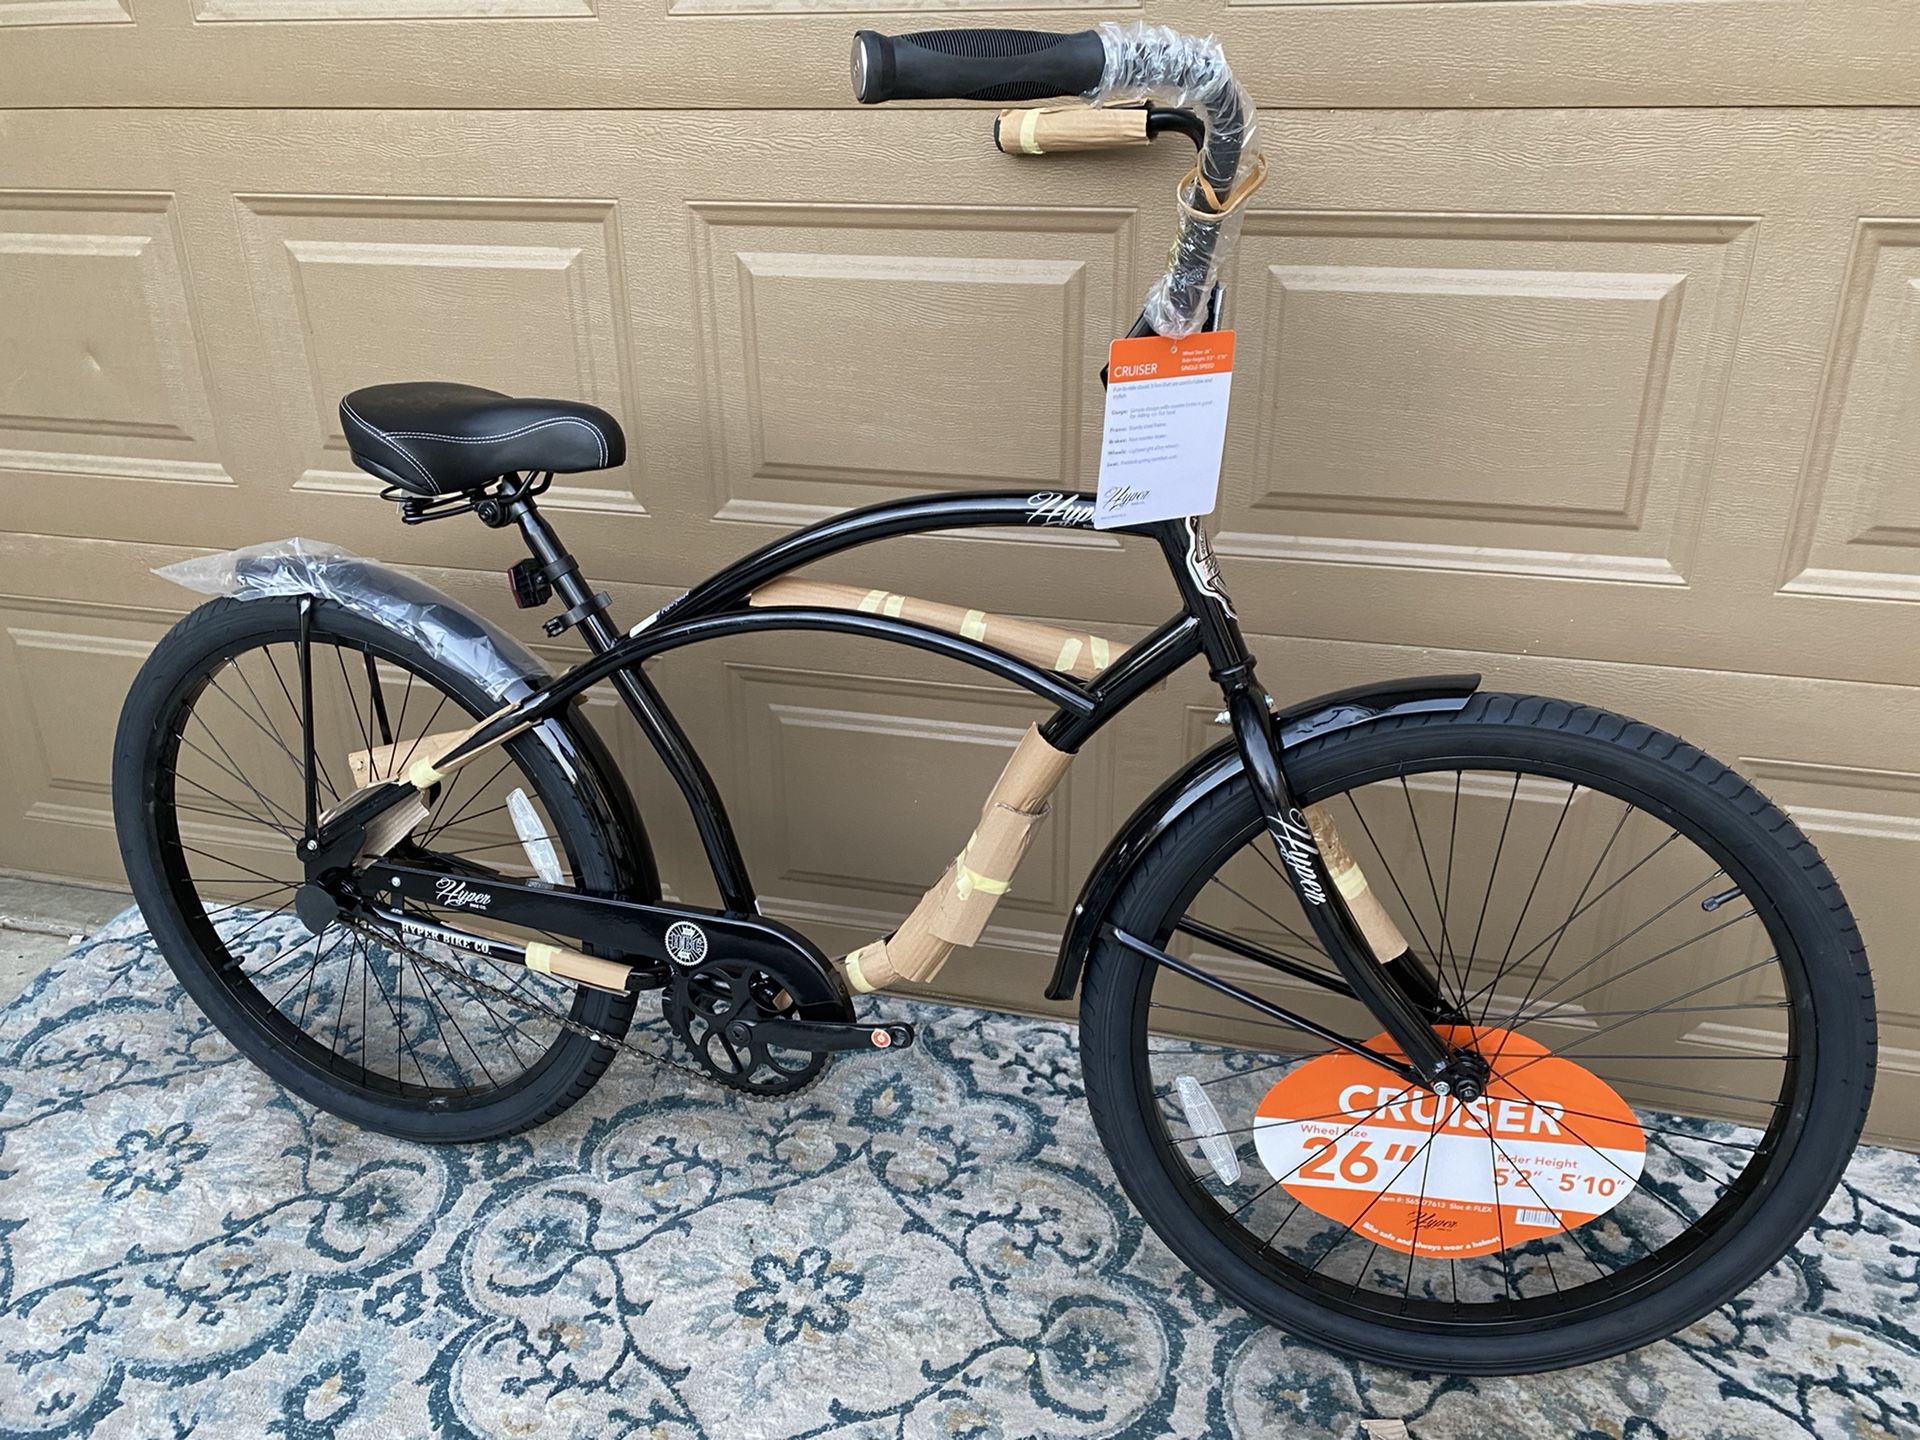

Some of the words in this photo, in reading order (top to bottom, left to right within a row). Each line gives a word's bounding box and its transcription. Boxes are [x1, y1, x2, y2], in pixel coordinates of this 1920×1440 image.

[1113, 363, 1158, 378] CRUISER
[1025, 491, 1096, 526] Hyp
[1267, 808, 1327, 905] Hyper
[435, 877, 491, 906] Hyper
[402, 921, 440, 940] HYPER
[443, 933, 471, 949] BIKE
[474, 942, 492, 955] CO.
[1338, 1084, 1564, 1136] CRUISER
[1301, 1124, 1339, 1135] Wheel
[1343, 1128, 1368, 1138] Size
[1299, 1136, 1417, 1184] 26"
[1535, 1156, 1578, 1169] Height
[1559, 1173, 1626, 1197] 5'10"
[1473, 1205, 1493, 1213] FLEX
[1379, 1229, 1396, 1241] safe
[1396, 1237, 1412, 1246] and
[1442, 1244, 1465, 1252] wear
